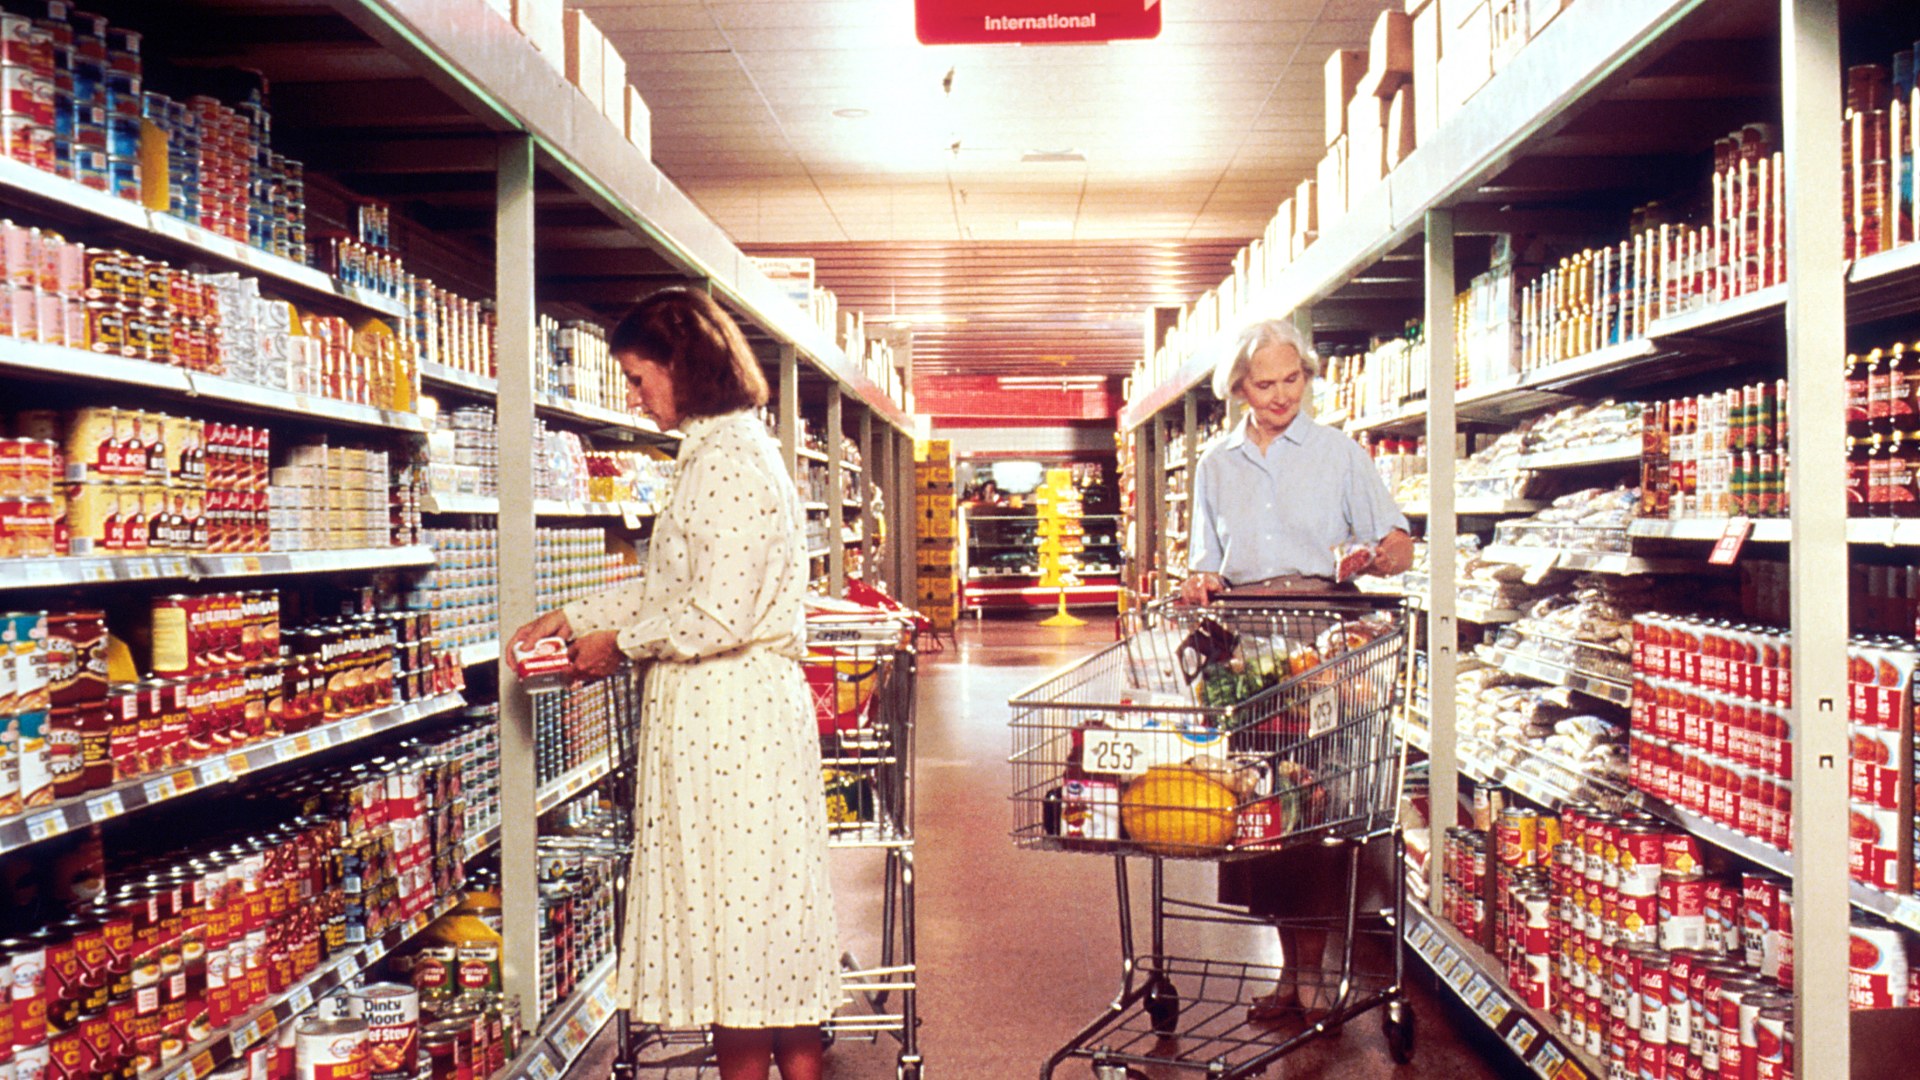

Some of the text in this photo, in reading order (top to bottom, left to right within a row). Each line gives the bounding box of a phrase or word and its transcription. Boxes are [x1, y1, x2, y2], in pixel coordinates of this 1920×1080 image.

[1097, 742, 1134, 770] 253
[363, 999, 402, 1013] Dinty
[361, 1012, 406, 1025] Moore
[382, 1027, 409, 1042] Stew
